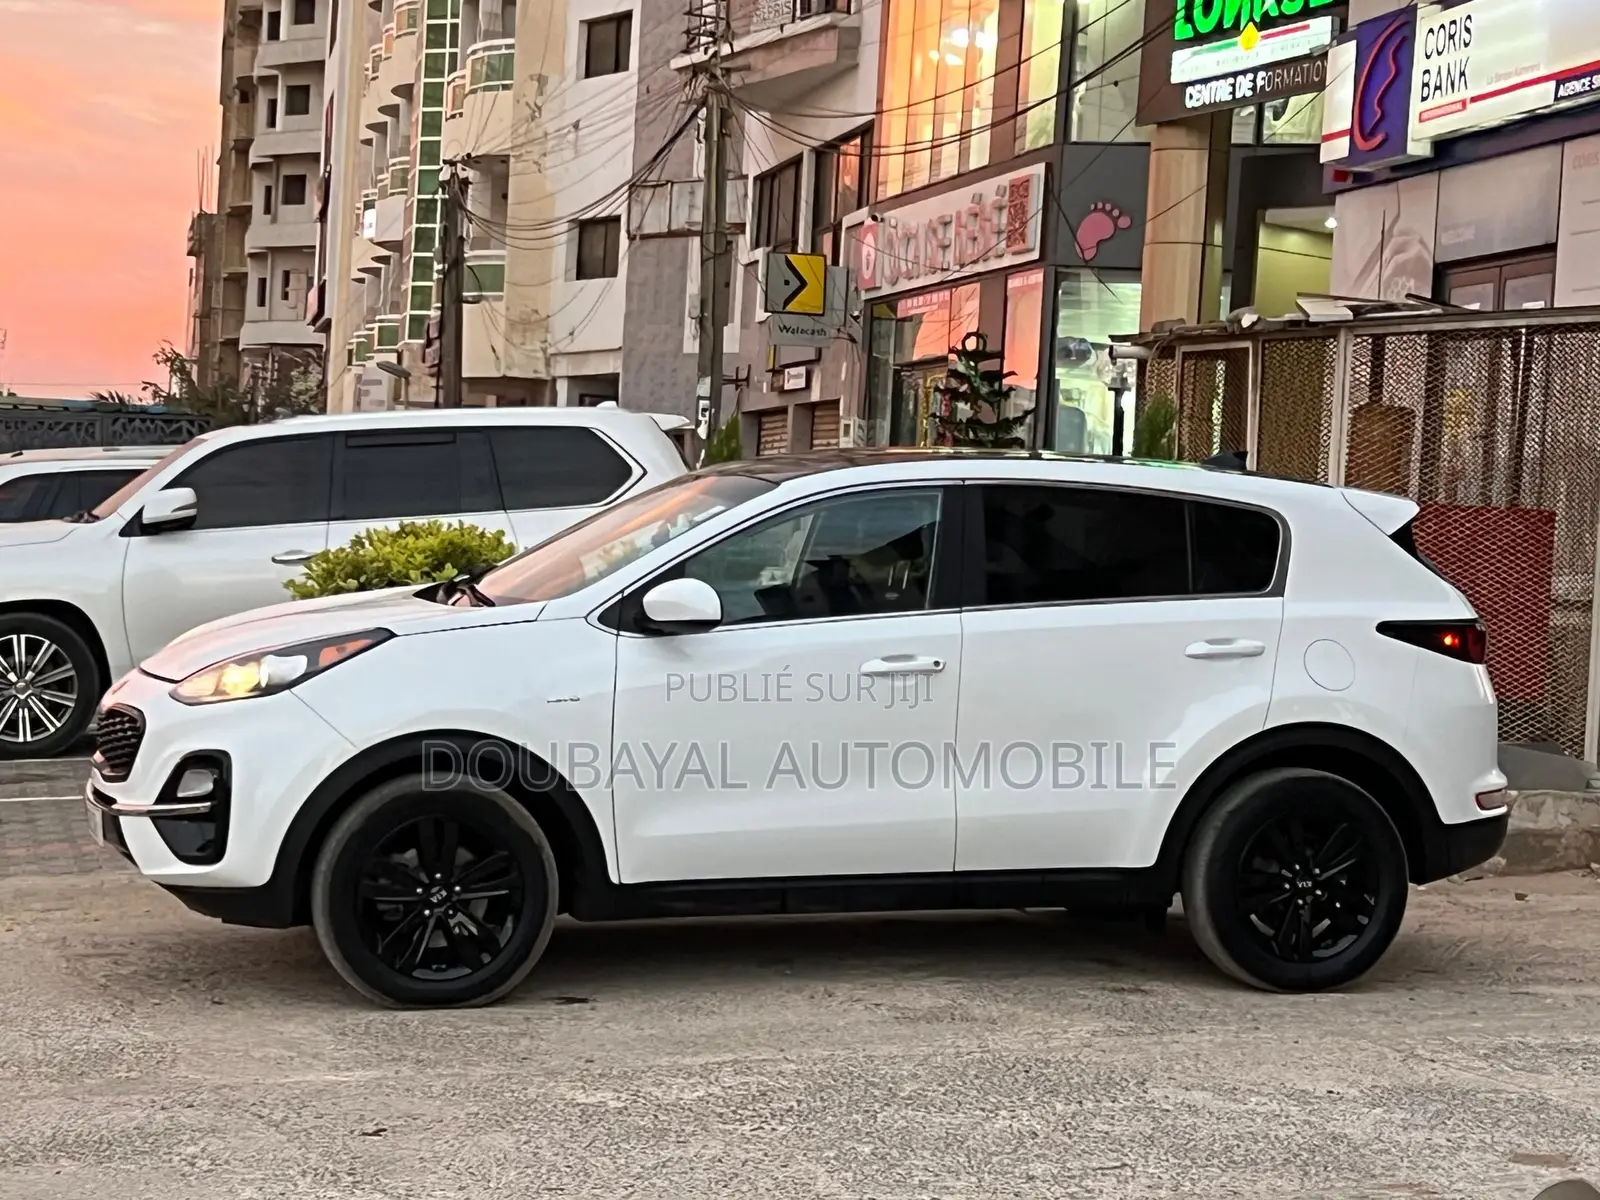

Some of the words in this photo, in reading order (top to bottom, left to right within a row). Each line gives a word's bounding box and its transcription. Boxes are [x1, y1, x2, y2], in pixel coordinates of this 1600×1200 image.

[1425, 14, 1473, 60] CORIS
[1184, 77, 1235, 109] CENTRE
[1235, 72, 1255, 98] DE
[1420, 56, 1470, 103] BANK
